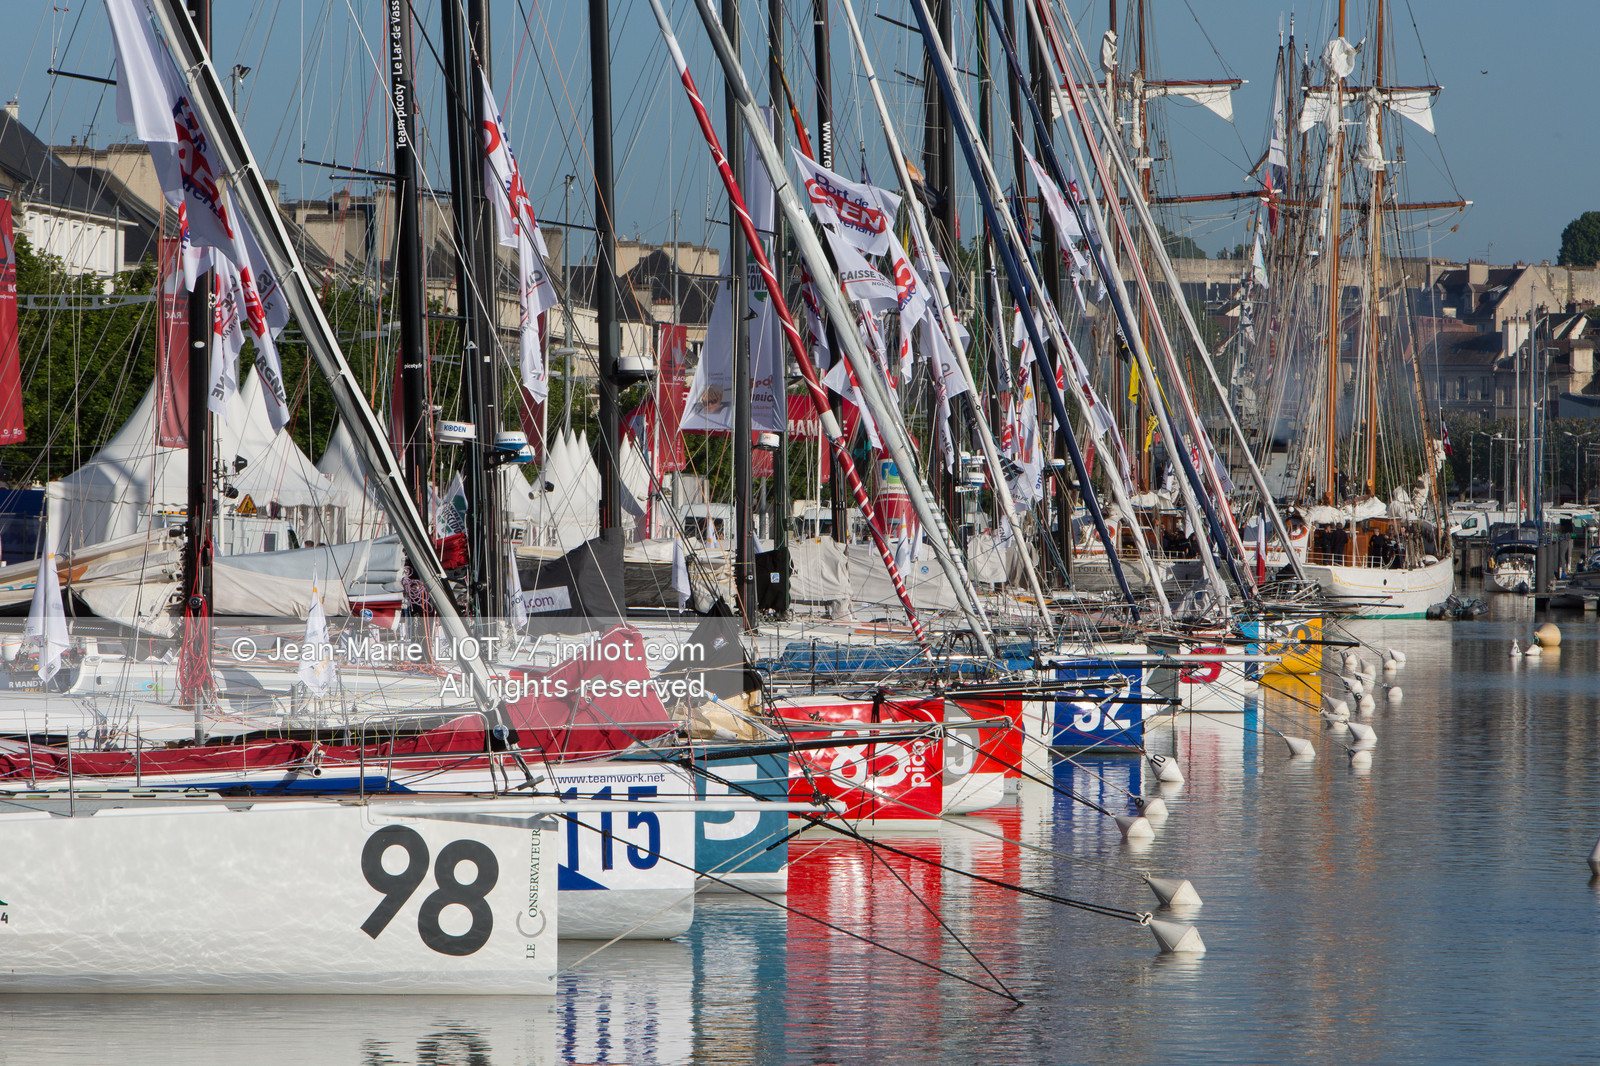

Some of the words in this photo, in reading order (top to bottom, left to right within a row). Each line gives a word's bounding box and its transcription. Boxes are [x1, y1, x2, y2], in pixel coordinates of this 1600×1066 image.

[390, 25, 401, 40] de
[391, 41, 402, 60] Lac
[392, 60, 403, 75] Le
[394, 83, 408, 117] picoty
[396, 119, 407, 150] Team
[814, 172, 849, 201] Port
[854, 197, 869, 209] de
[840, 269, 877, 281] CAISSE
[443, 424, 467, 433] KODEN
[1073, 675, 1131, 732] 52
[830, 719, 913, 789] 85
[1151, 753, 1167, 768] 10
[557, 773, 666, 784] www.teamwork.net
[558, 785, 661, 871] 115
[360, 824, 499, 957] 98
[516, 828, 547, 938] CONSERVATEUR
[526, 943, 535, 960] LE
